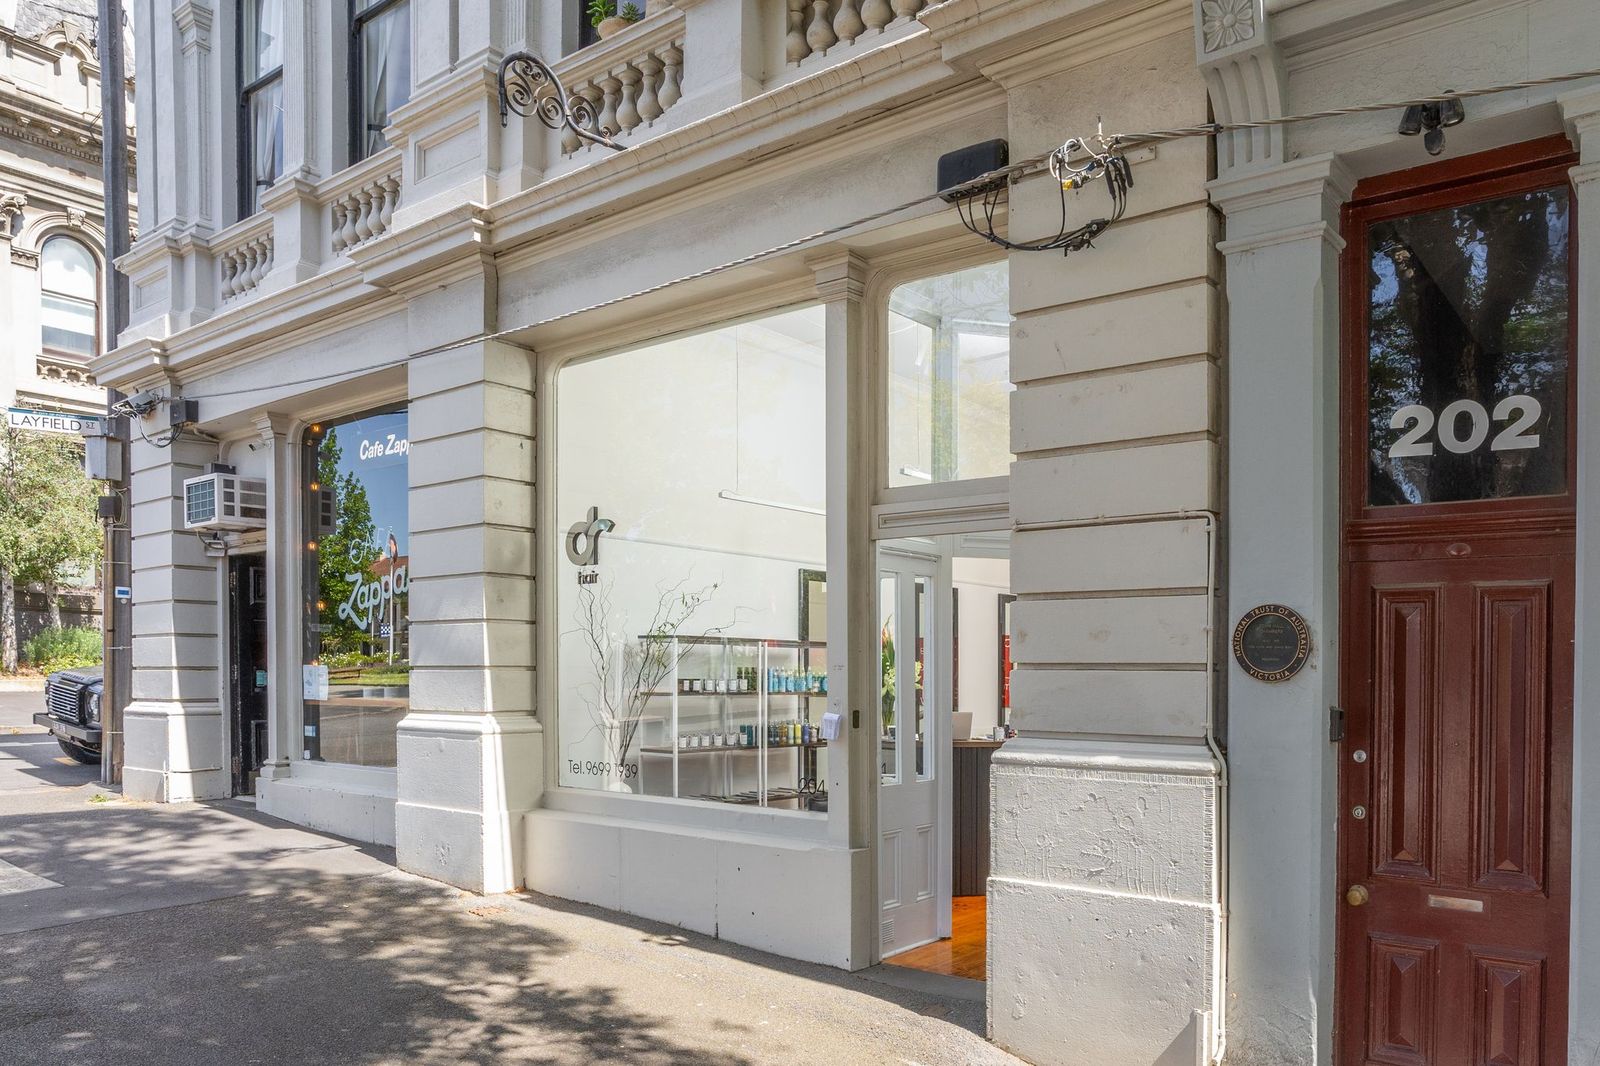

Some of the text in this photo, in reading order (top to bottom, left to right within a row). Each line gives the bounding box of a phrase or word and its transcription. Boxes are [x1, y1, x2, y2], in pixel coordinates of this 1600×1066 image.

[11, 413, 82, 431] LAYFIELD
[85, 421, 96, 429] ST
[1388, 394, 1542, 458] 202
[359, 439, 384, 460] Cafe
[578, 570, 600, 585] hair
[1233, 617, 1250, 657] NATIONAL
[1251, 606, 1274, 617] TRUST
[1278, 607, 1289, 615] OF
[1290, 616, 1307, 658] AUSTRALIA
[1249, 669, 1290, 680] VICTORIA
[614, 762, 639, 778] 1939
[798, 777, 825, 795] 204
